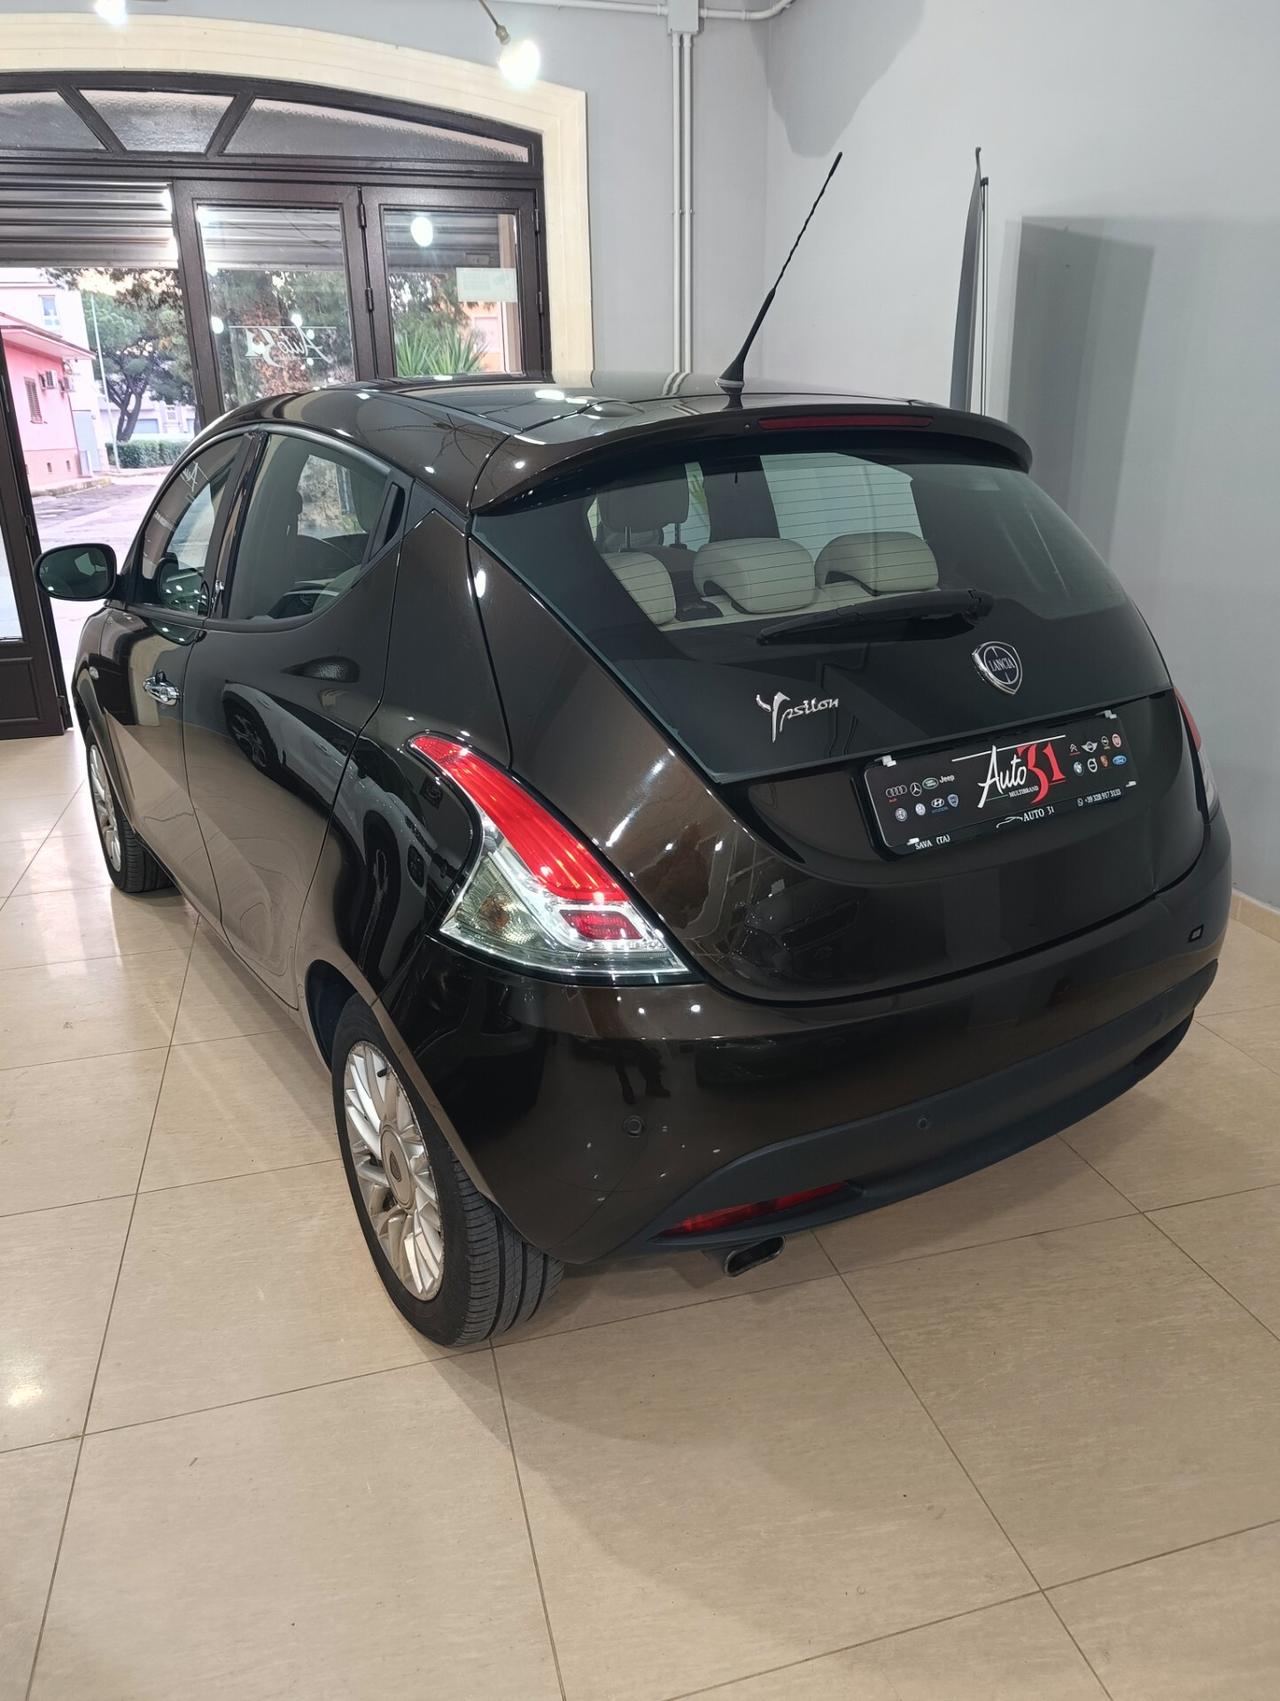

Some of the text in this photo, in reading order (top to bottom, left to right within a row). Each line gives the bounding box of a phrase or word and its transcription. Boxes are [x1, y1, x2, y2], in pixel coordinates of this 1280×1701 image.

[989, 657, 1015, 672] LANCIA
[755, 691, 839, 743] Ypsilon
[939, 774, 955, 784] Jeep
[977, 742, 1066, 808] Auto 31
[1023, 806, 1055, 822] AUTO 31
